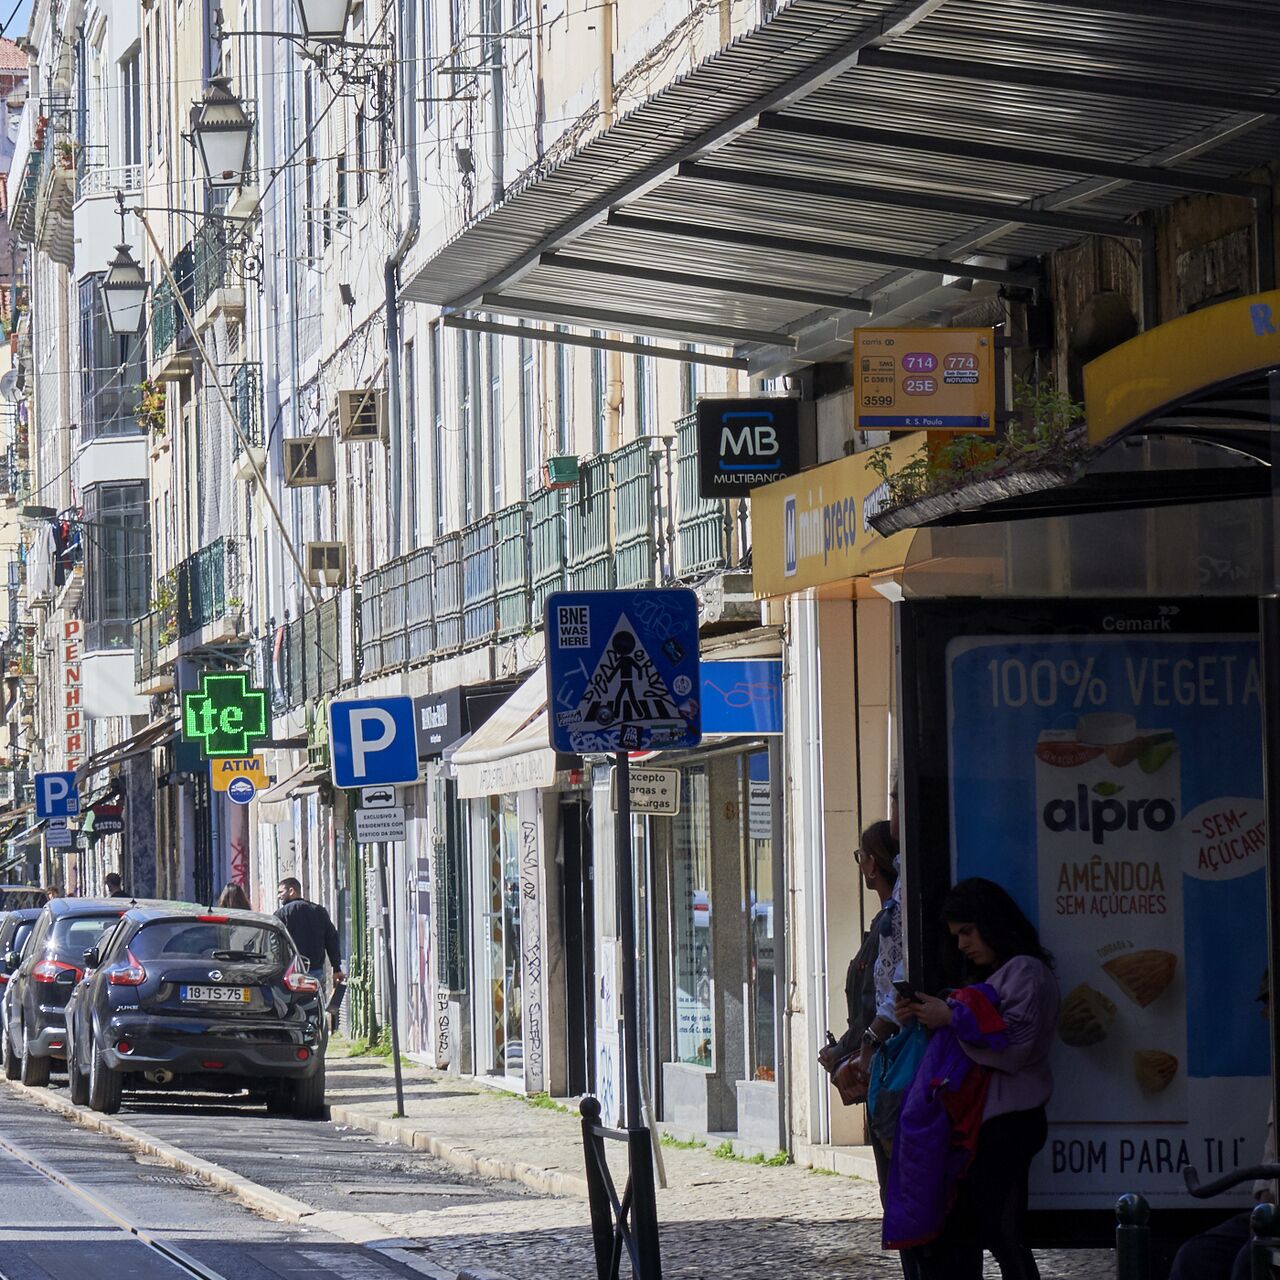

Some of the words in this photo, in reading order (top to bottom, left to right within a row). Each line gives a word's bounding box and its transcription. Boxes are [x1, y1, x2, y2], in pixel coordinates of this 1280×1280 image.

[907, 357, 933, 368] 714
[948, 357, 974, 369] 774
[907, 380, 934, 392] 25E
[864, 395, 893, 406] 3599
[719, 425, 780, 456] MB
[799, 486, 856, 567] minipreço
[559, 607, 588, 625] BNE
[1102, 616, 1172, 631] Cemark
[560, 626, 589, 636] WAS
[560, 636, 589, 647] HERE
[988, 656, 1108, 709] 100%
[348, 707, 397, 778] P
[222, 759, 260, 772] ATM
[629, 771, 666, 783] xcepto
[44, 777, 69, 813] P
[630, 786, 657, 797] argas
[660, 787, 667, 795] e
[1043, 783, 1176, 845] alpro
[1057, 855, 1165, 893] AMÊNDOA
[1056, 895, 1087, 916] SEM
[1090, 892, 1168, 919] AÇÚCARES
[1052, 1139, 1107, 1174] BOM
[1120, 1138, 1191, 1174] PARA
